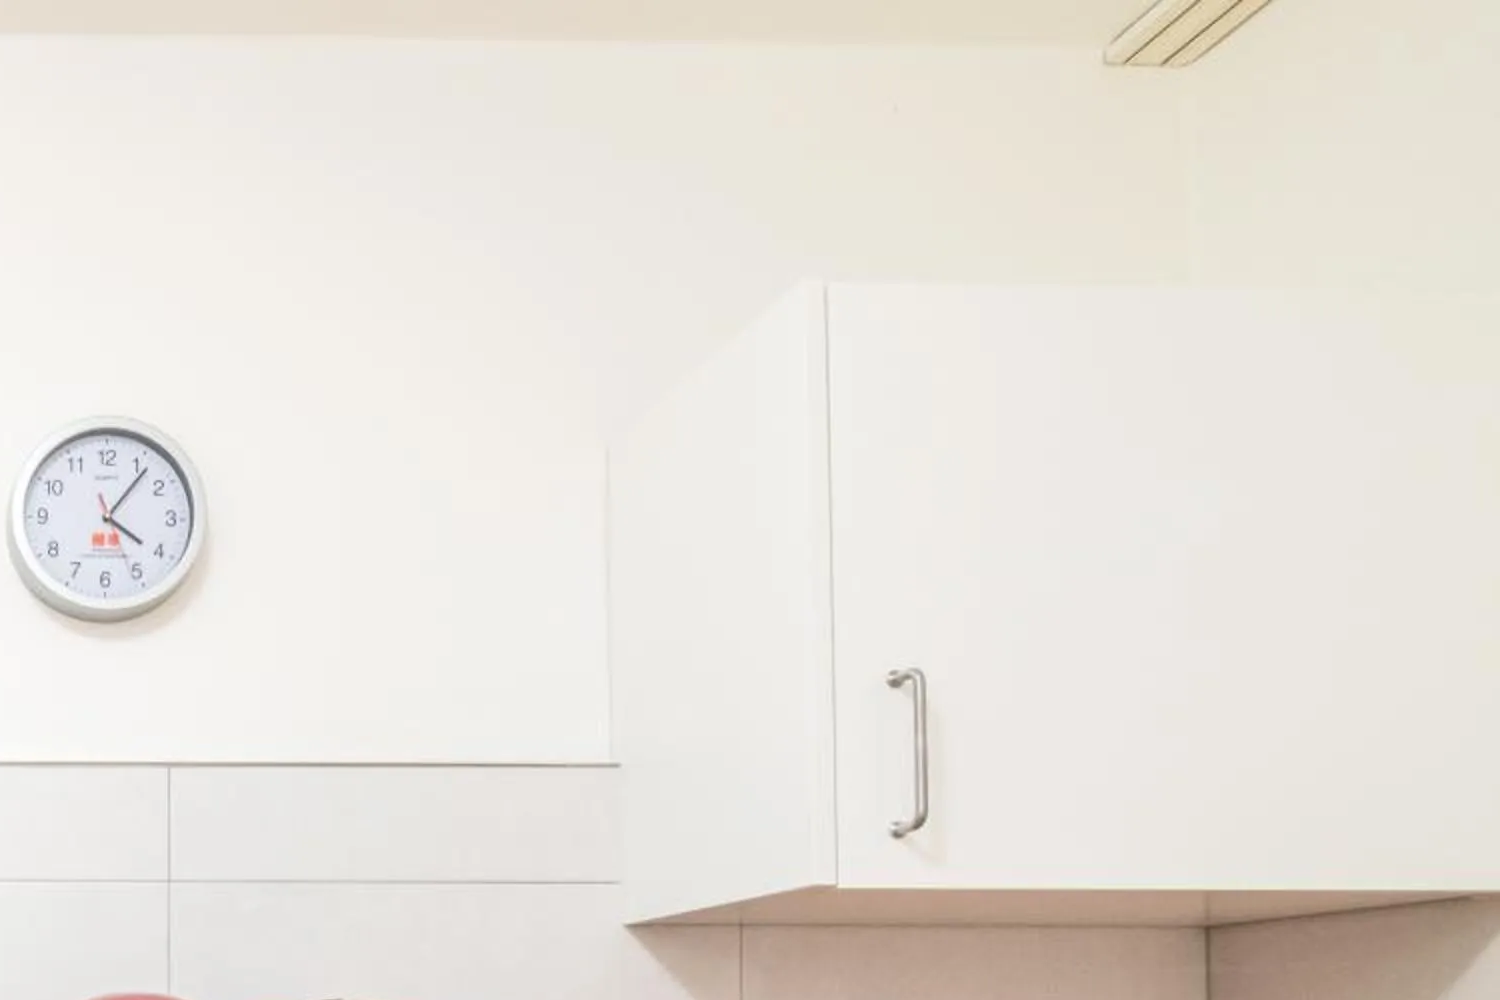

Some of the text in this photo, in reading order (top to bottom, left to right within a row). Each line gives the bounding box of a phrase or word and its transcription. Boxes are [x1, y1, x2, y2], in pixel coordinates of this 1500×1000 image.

[68, 456, 84, 473] 11
[98, 449, 117, 467] 12
[132, 457, 141, 474] 1
[45, 479, 64, 496] 10
[152, 479, 166, 497] 2
[36, 507, 49, 525] 9
[165, 509, 178, 527] 3
[47, 541, 60, 558] 8
[152, 543, 165, 559] 4
[69, 561, 82, 579] 7
[131, 563, 143, 580] 5
[99, 571, 112, 588] 6
